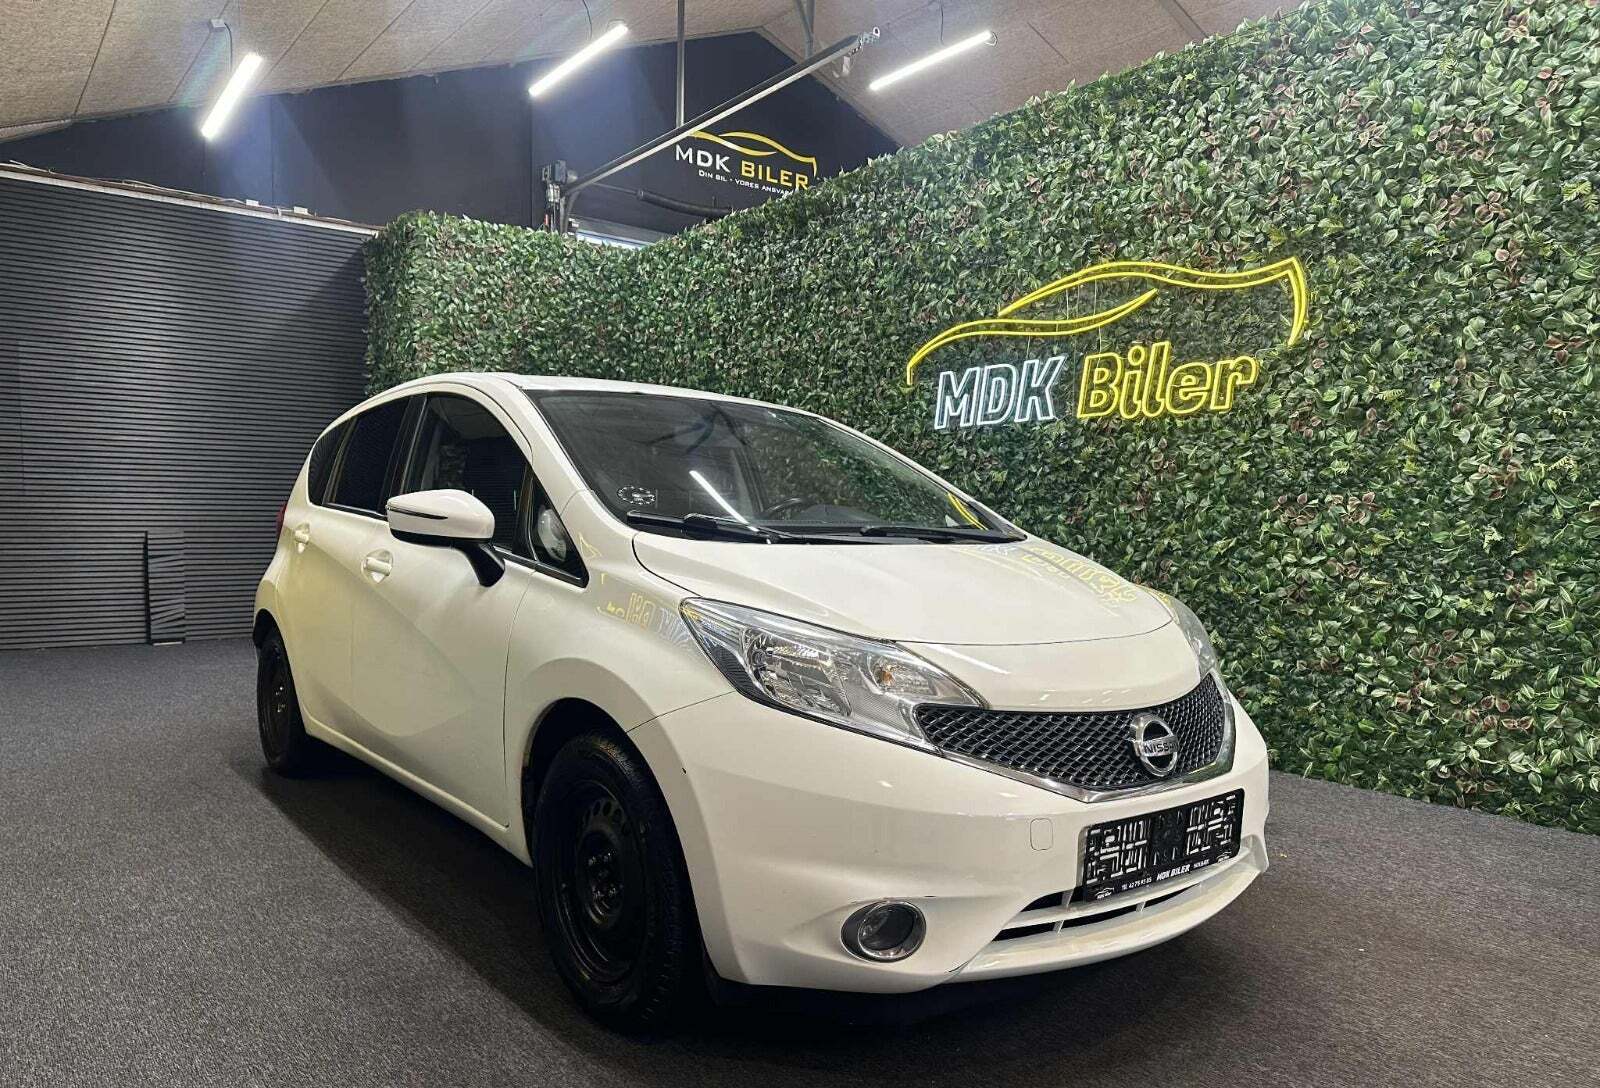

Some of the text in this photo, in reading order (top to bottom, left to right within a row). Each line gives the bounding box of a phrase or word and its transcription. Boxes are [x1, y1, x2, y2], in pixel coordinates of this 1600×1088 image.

[676, 144, 808, 190] MDK BILER
[934, 340, 1260, 430] MDK Biler
